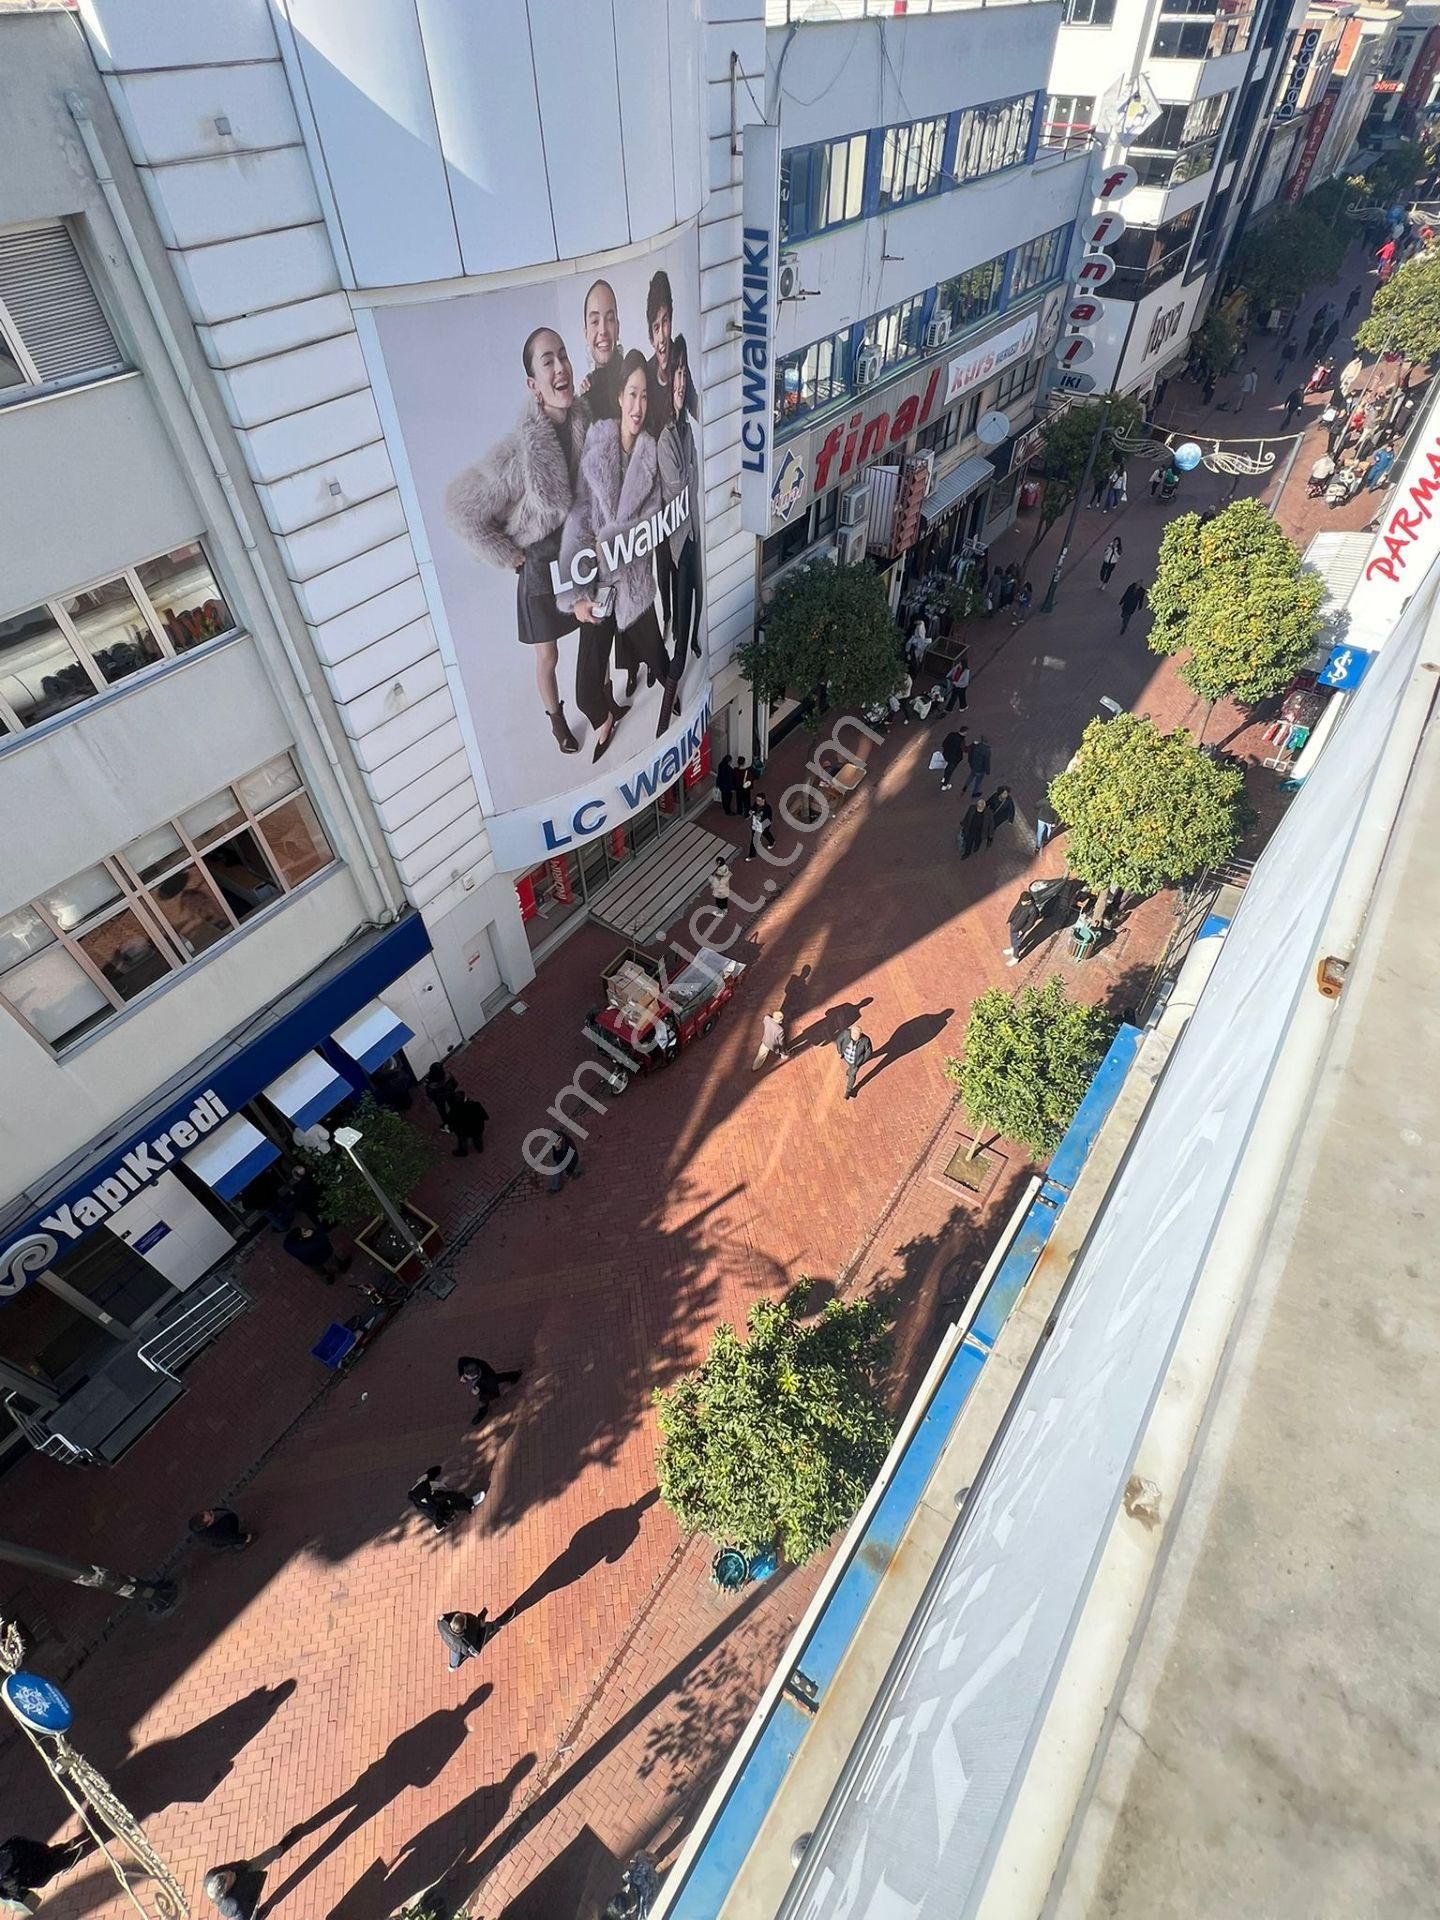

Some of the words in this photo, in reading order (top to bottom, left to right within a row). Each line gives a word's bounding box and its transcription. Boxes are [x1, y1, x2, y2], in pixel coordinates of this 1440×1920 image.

[1279, 31, 1320, 118] DeFacto
[742, 419, 765, 474] LC
[813, 367, 942, 493] final
[549, 548, 598, 595] LC
[541, 800, 607, 851] LC
